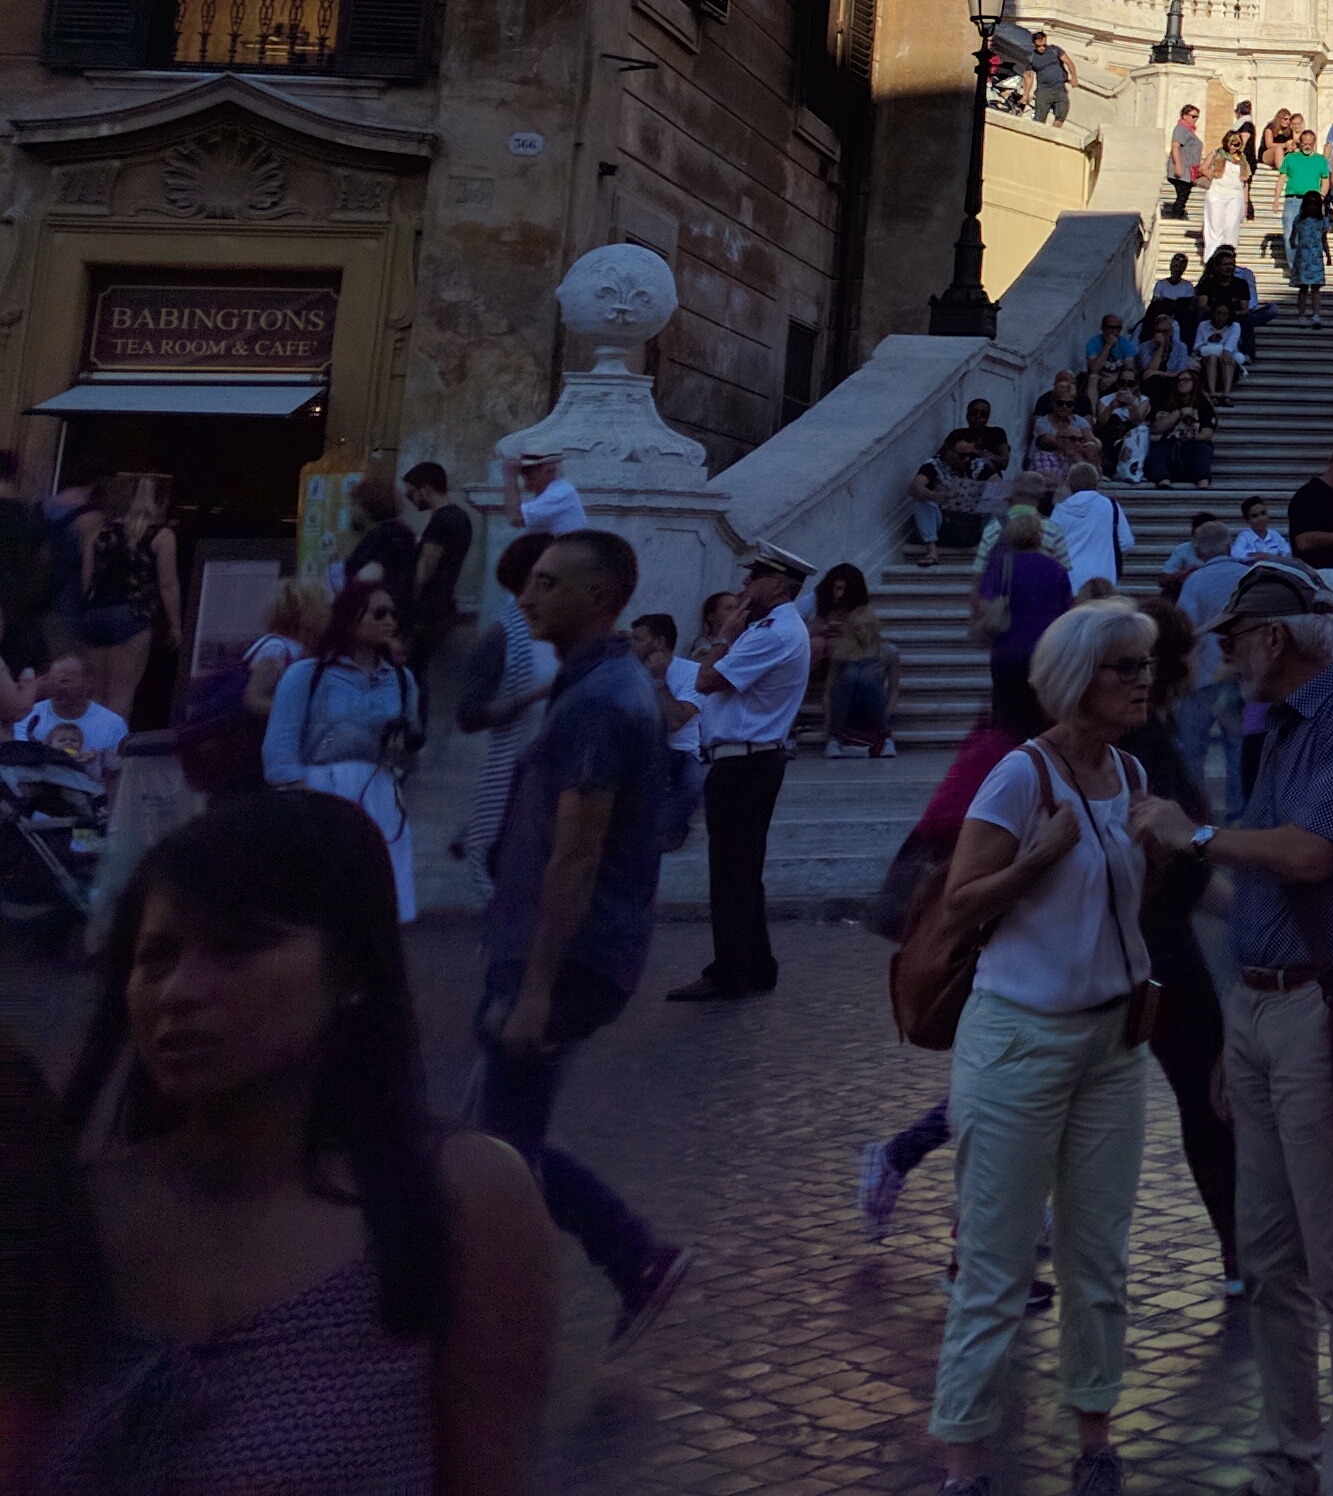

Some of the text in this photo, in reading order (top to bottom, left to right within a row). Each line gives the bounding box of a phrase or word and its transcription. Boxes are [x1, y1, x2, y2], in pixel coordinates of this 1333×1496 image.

[111, 306, 325, 332] BABINGTONS
[113, 339, 155, 355] TEA
[159, 339, 226, 356] ROOM
[231, 340, 250, 356] &
